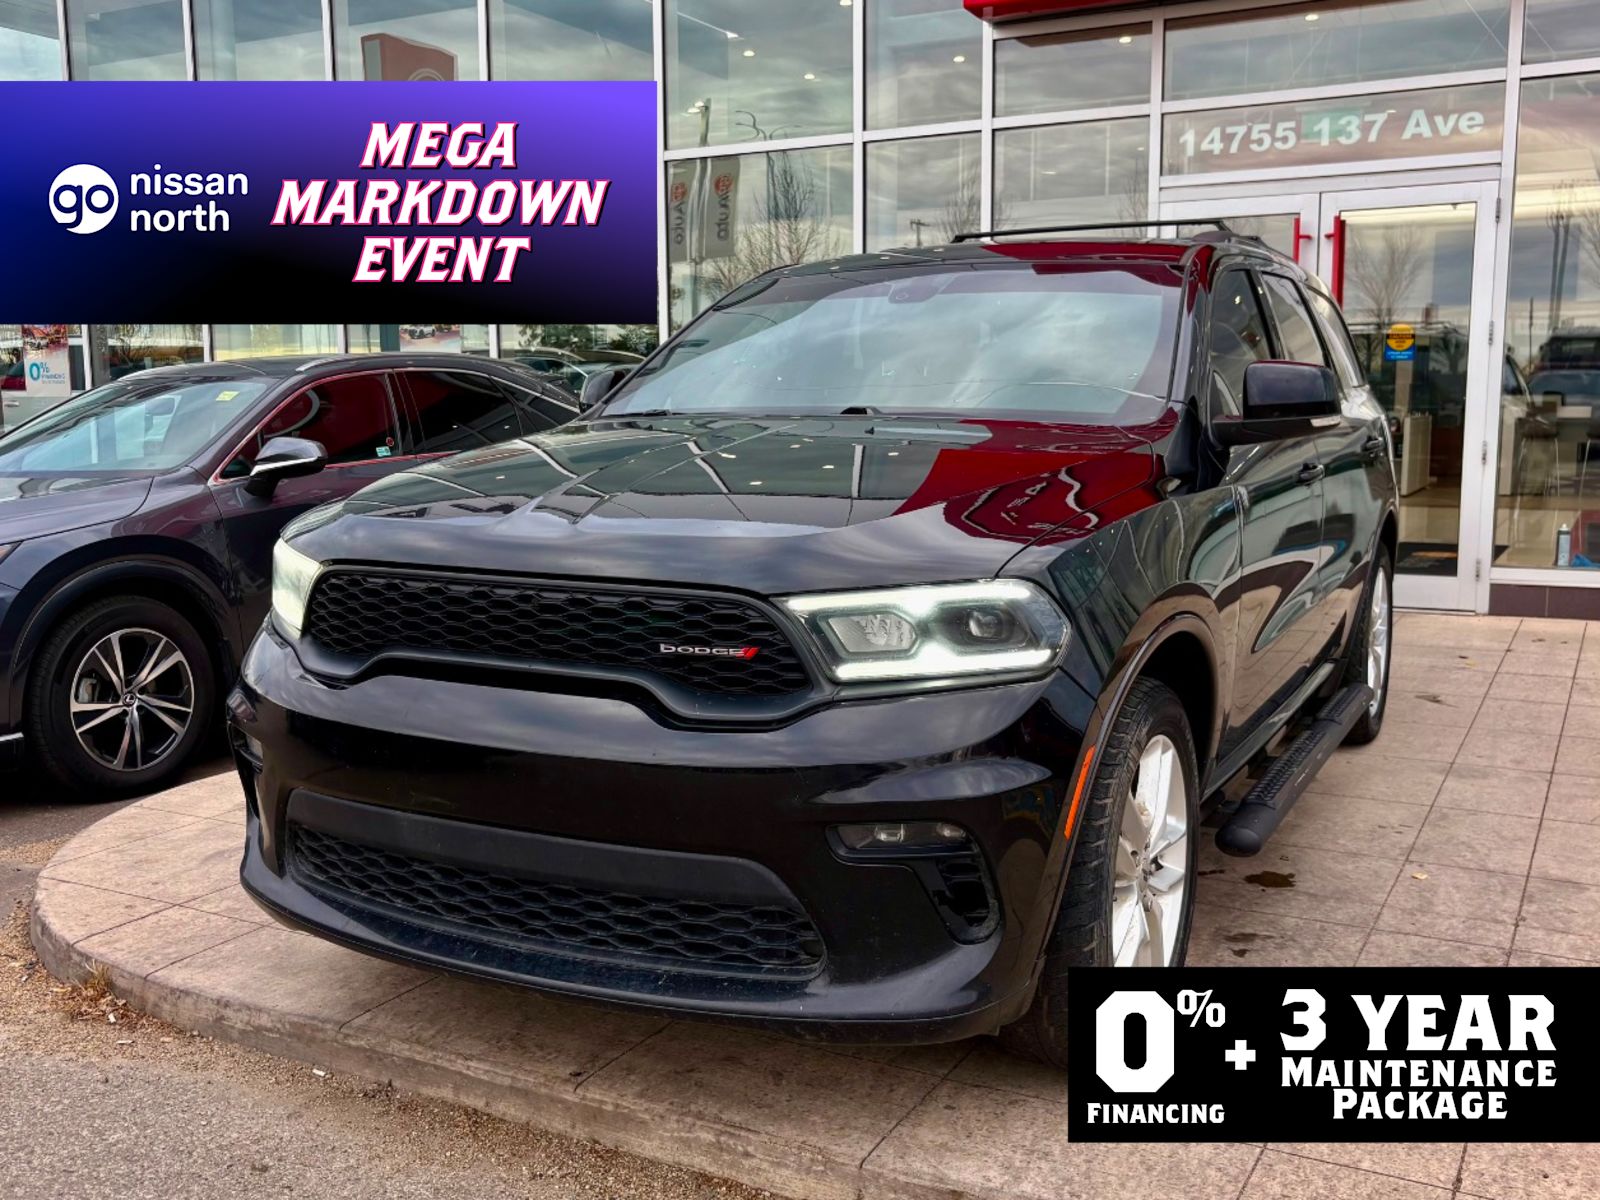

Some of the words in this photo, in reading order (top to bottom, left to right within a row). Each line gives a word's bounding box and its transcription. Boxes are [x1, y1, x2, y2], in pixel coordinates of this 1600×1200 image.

[1178, 121, 1297, 157] 14755
[1313, 112, 1388, 147] 137
[1400, 109, 1484, 141] Ave
[659, 643, 746, 657] DODGE
